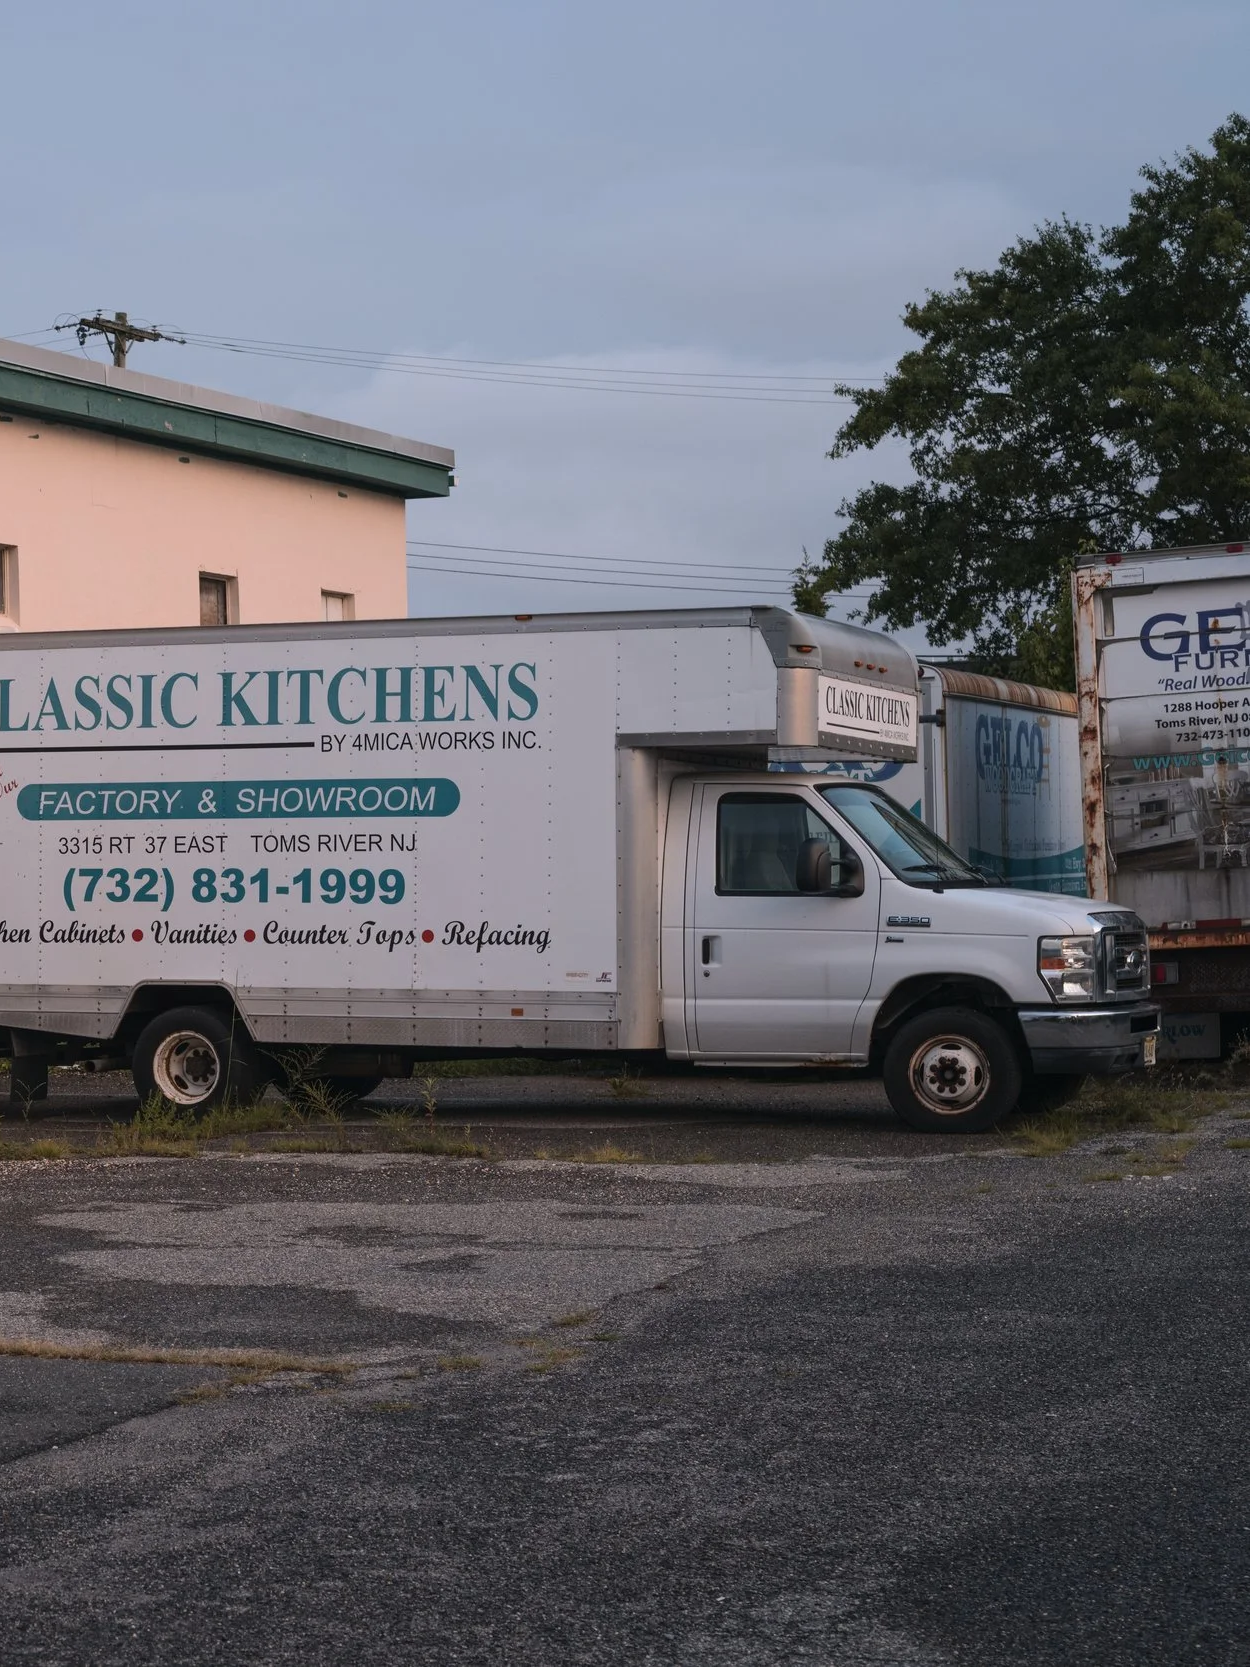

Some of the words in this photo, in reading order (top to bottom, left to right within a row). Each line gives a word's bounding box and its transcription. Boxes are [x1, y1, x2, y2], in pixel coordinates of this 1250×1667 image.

[216, 662, 539, 726] KITCHENS
[826, 686, 864, 719] CLASSIC
[866, 694, 910, 727] KITCHENS
[1164, 703, 1192, 713] 1288
[1195, 699, 1239, 711] Hooper
[1155, 719, 1186, 729] Toms
[1188, 716, 1221, 726] River,
[1224, 714, 1239, 724] NJ
[1242, 713, 1250, 722] 0
[321, 734, 347, 752] BY
[352, 732, 413, 751] 4MICA
[419, 731, 495, 750] WORKS
[502, 731, 541, 749] INC.
[975, 713, 1044, 783] GELCO
[39, 789, 182, 815] FACTORY
[197, 788, 217, 813] &
[236, 786, 436, 813] SHOWROOM
[58, 837, 103, 854] 3315
[109, 836, 135, 854] RT
[145, 836, 167, 854] 37
[174, 835, 228, 853] EAST
[250, 834, 310, 852] TOMS
[318, 834, 383, 852] RIVER
[390, 833, 417, 851] NJ
[63, 868, 174, 912] (732)
[191, 868, 406, 905] 831-1999
[38, 920, 126, 944] Cabinets
[150, 920, 238, 945] Vanities
[263, 920, 349, 946] Counter
[356, 921, 416, 952] Tops
[441, 921, 552, 953] Refacing
